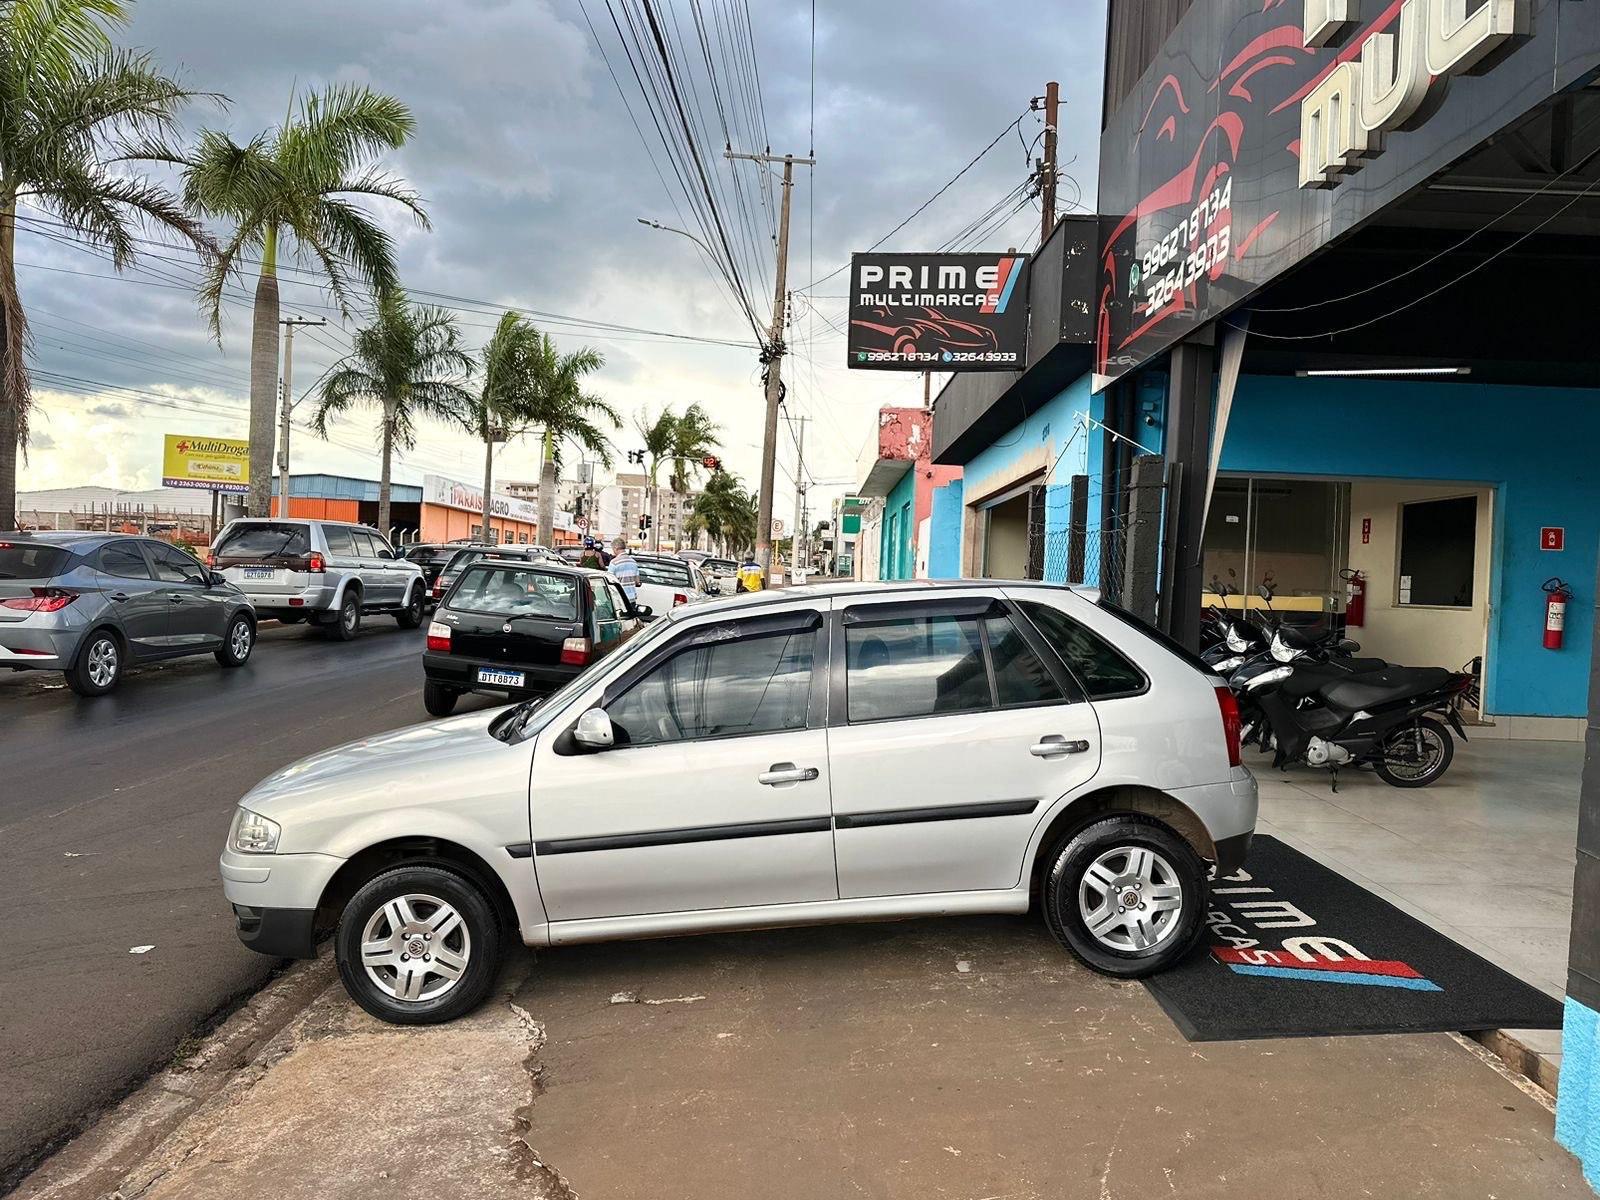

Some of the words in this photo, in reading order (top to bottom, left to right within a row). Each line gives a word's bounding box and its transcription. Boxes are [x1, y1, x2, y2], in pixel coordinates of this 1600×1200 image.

[1141, 175, 1233, 282] 996278734
[860, 265, 999, 290] PRIME
[860, 293, 1000, 307] MULTIMARCAS
[867, 352, 939, 362] 996278734
[952, 352, 1017, 362] 32643933
[490, 498, 509, 516] AGRO
[481, 673, 519, 685] DTT8B73
